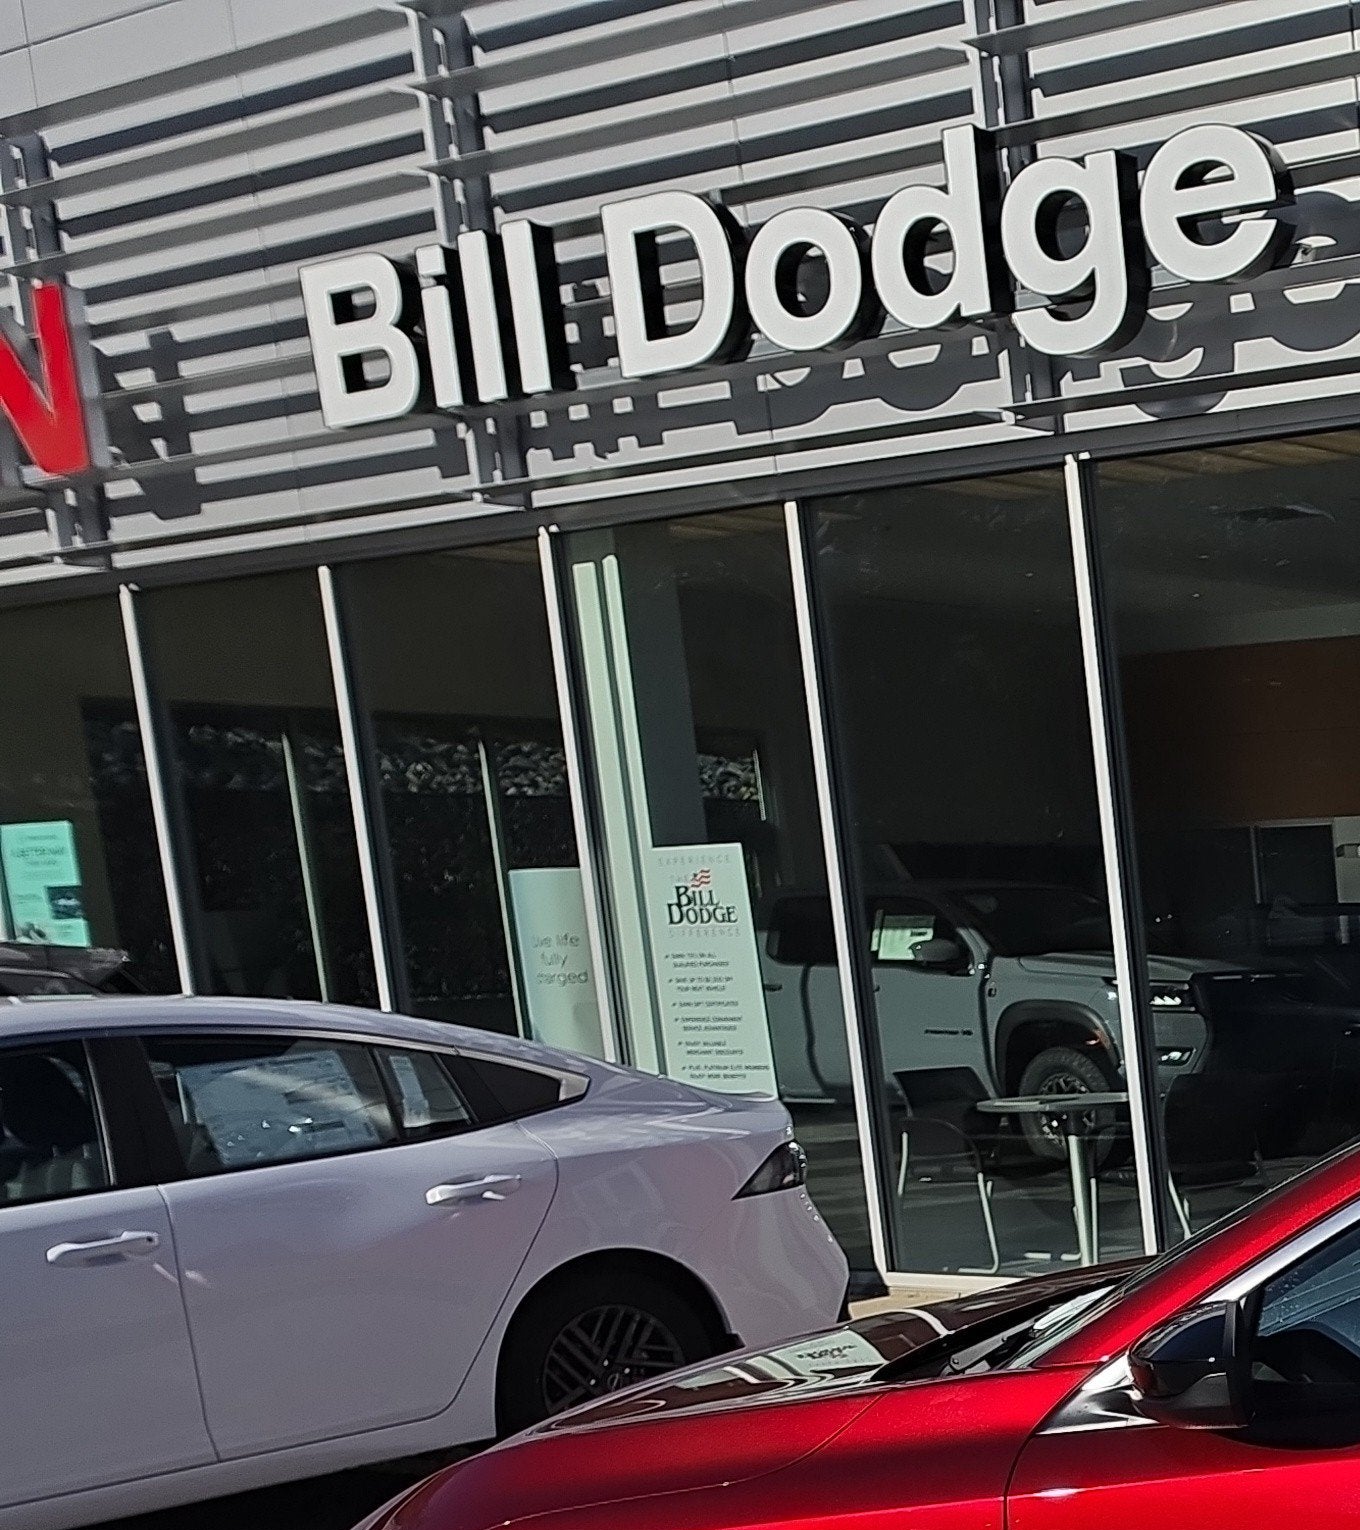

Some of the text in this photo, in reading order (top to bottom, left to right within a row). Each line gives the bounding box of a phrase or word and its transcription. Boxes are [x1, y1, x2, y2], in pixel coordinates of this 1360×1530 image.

[298, 123, 1280, 428] Bill Dodge
[674, 886, 720, 907] BILL
[667, 903, 738, 925] DODGE
